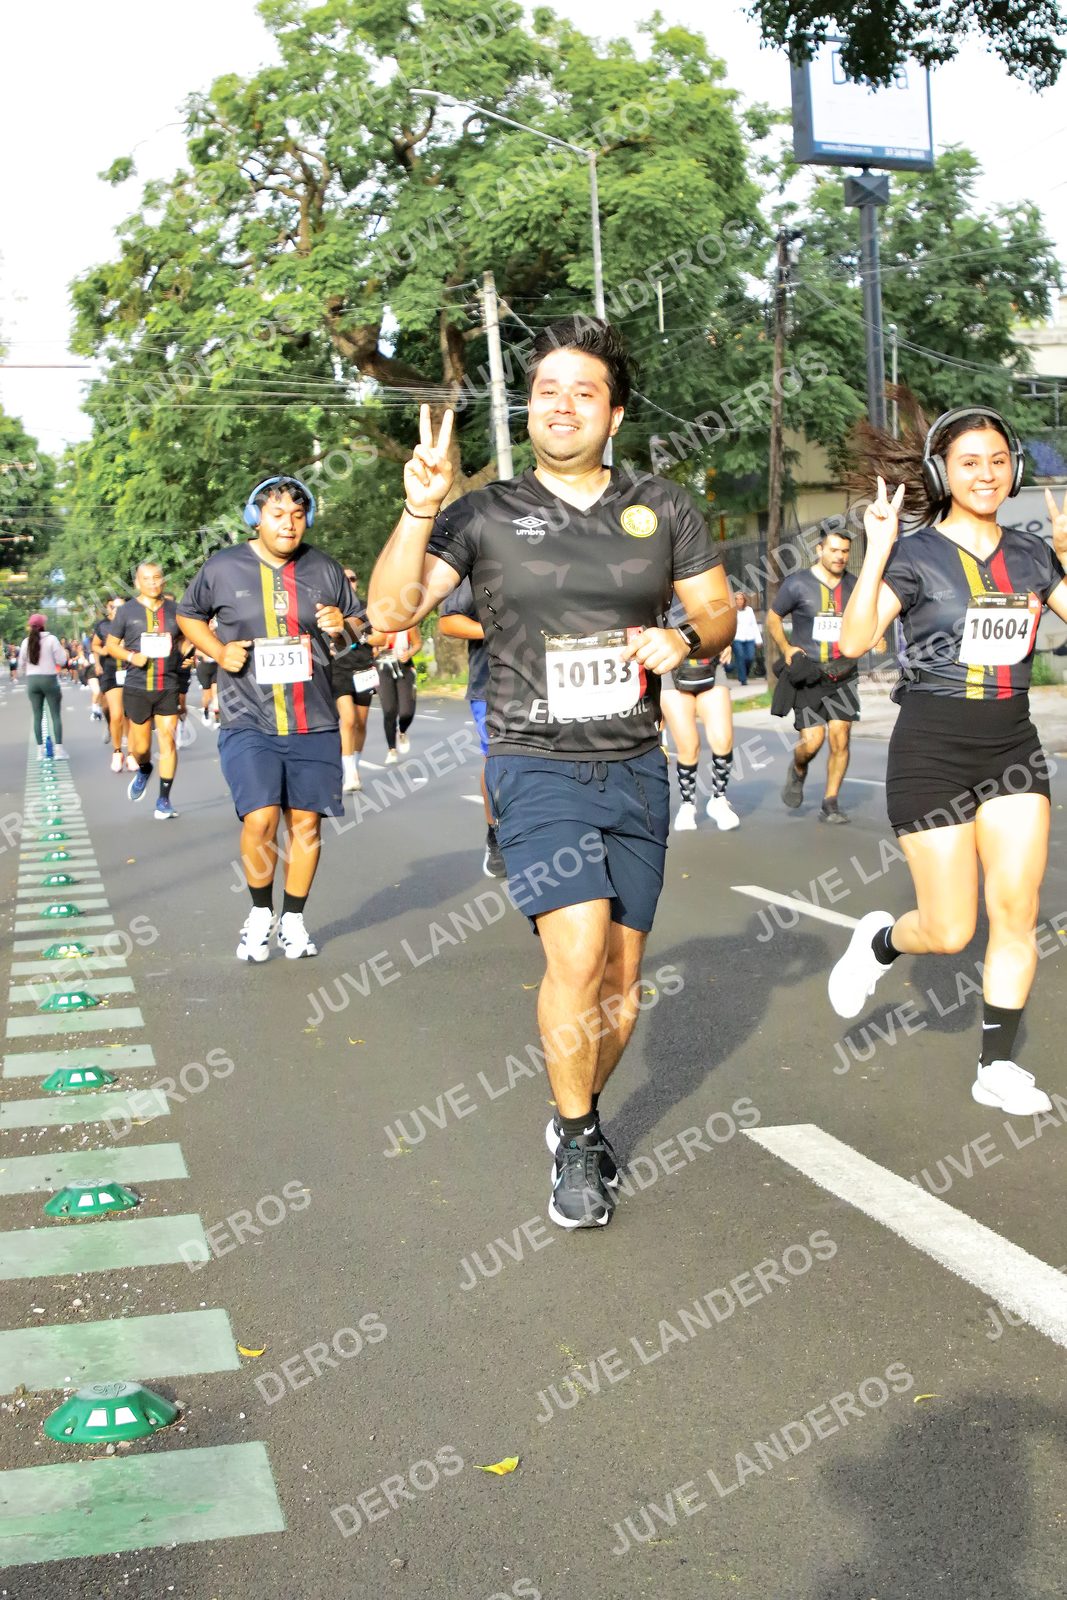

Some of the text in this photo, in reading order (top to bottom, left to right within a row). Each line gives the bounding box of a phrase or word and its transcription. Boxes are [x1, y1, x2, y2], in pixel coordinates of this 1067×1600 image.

[516, 527, 546, 536] umbro
[970, 618, 1029, 640] 10604
[260, 651, 303, 667] 12351
[553, 658, 632, 688] 10133
